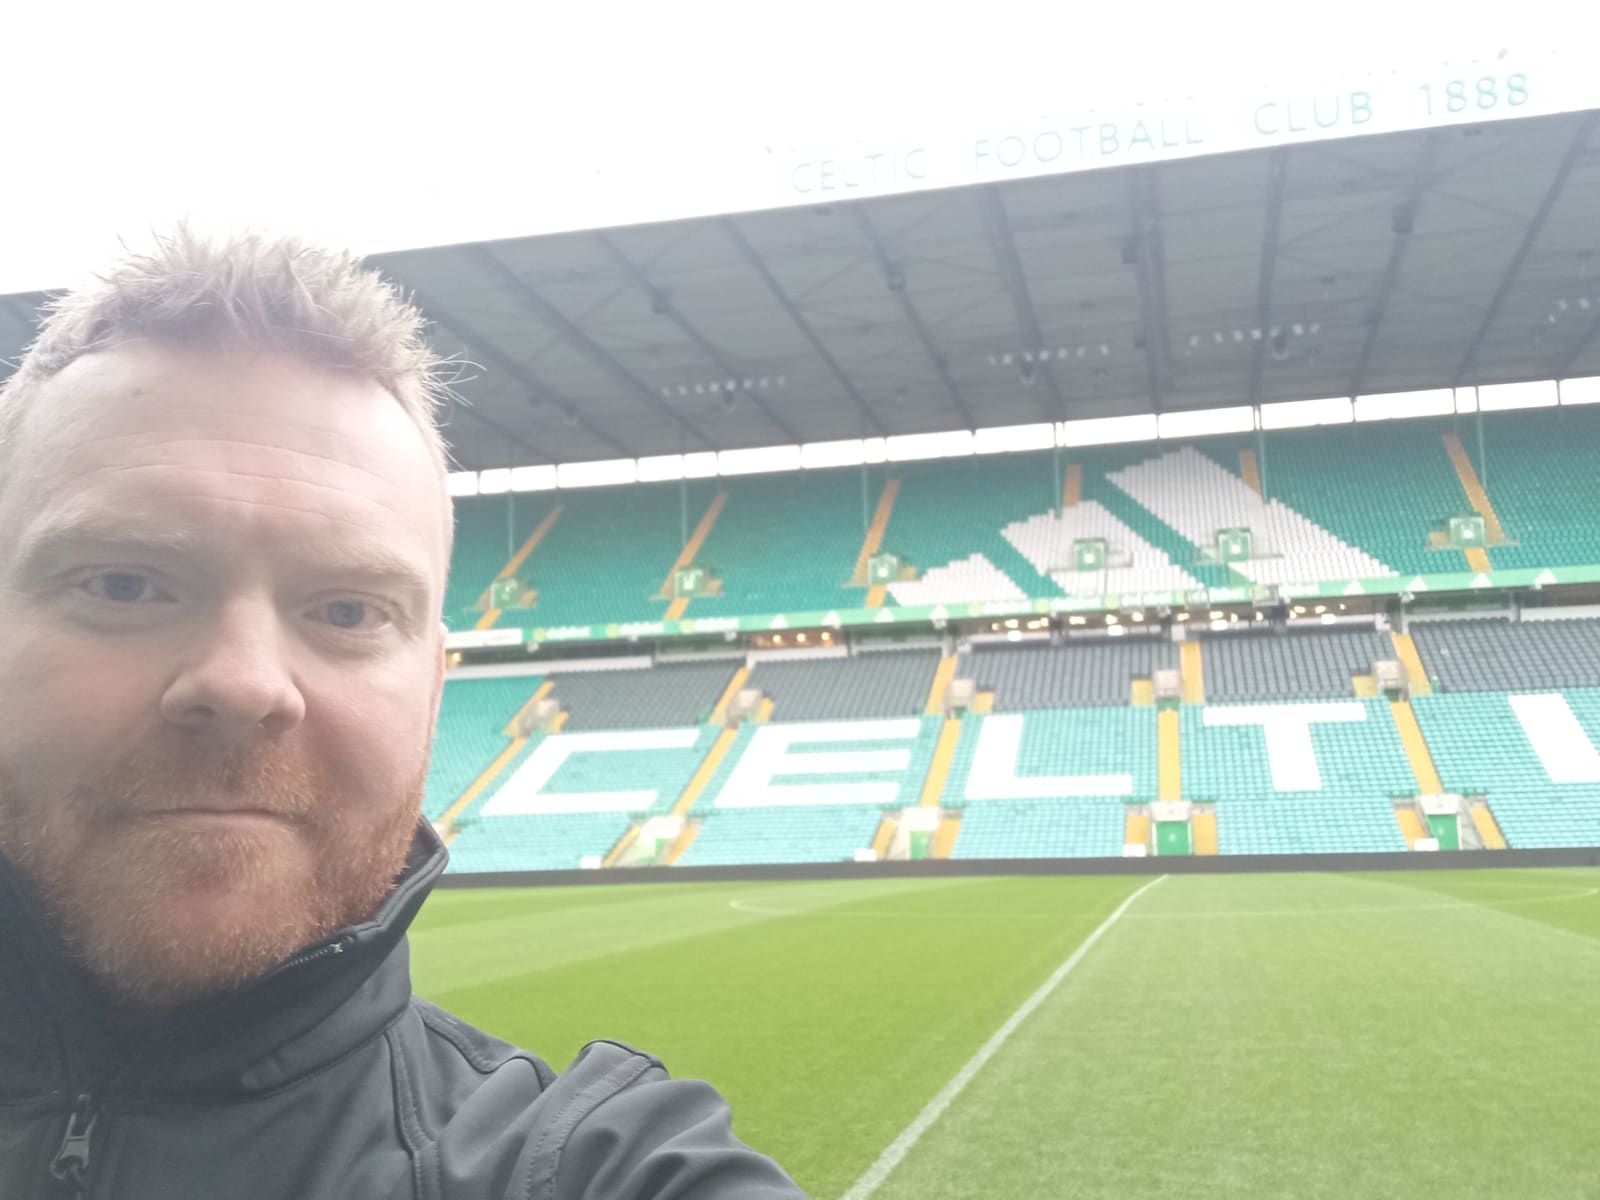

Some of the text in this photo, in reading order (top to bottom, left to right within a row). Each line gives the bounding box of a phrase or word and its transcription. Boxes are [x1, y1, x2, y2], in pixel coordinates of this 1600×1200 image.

[792, 73, 1528, 193] CELTIC FOOTBALL CLUB 1888
